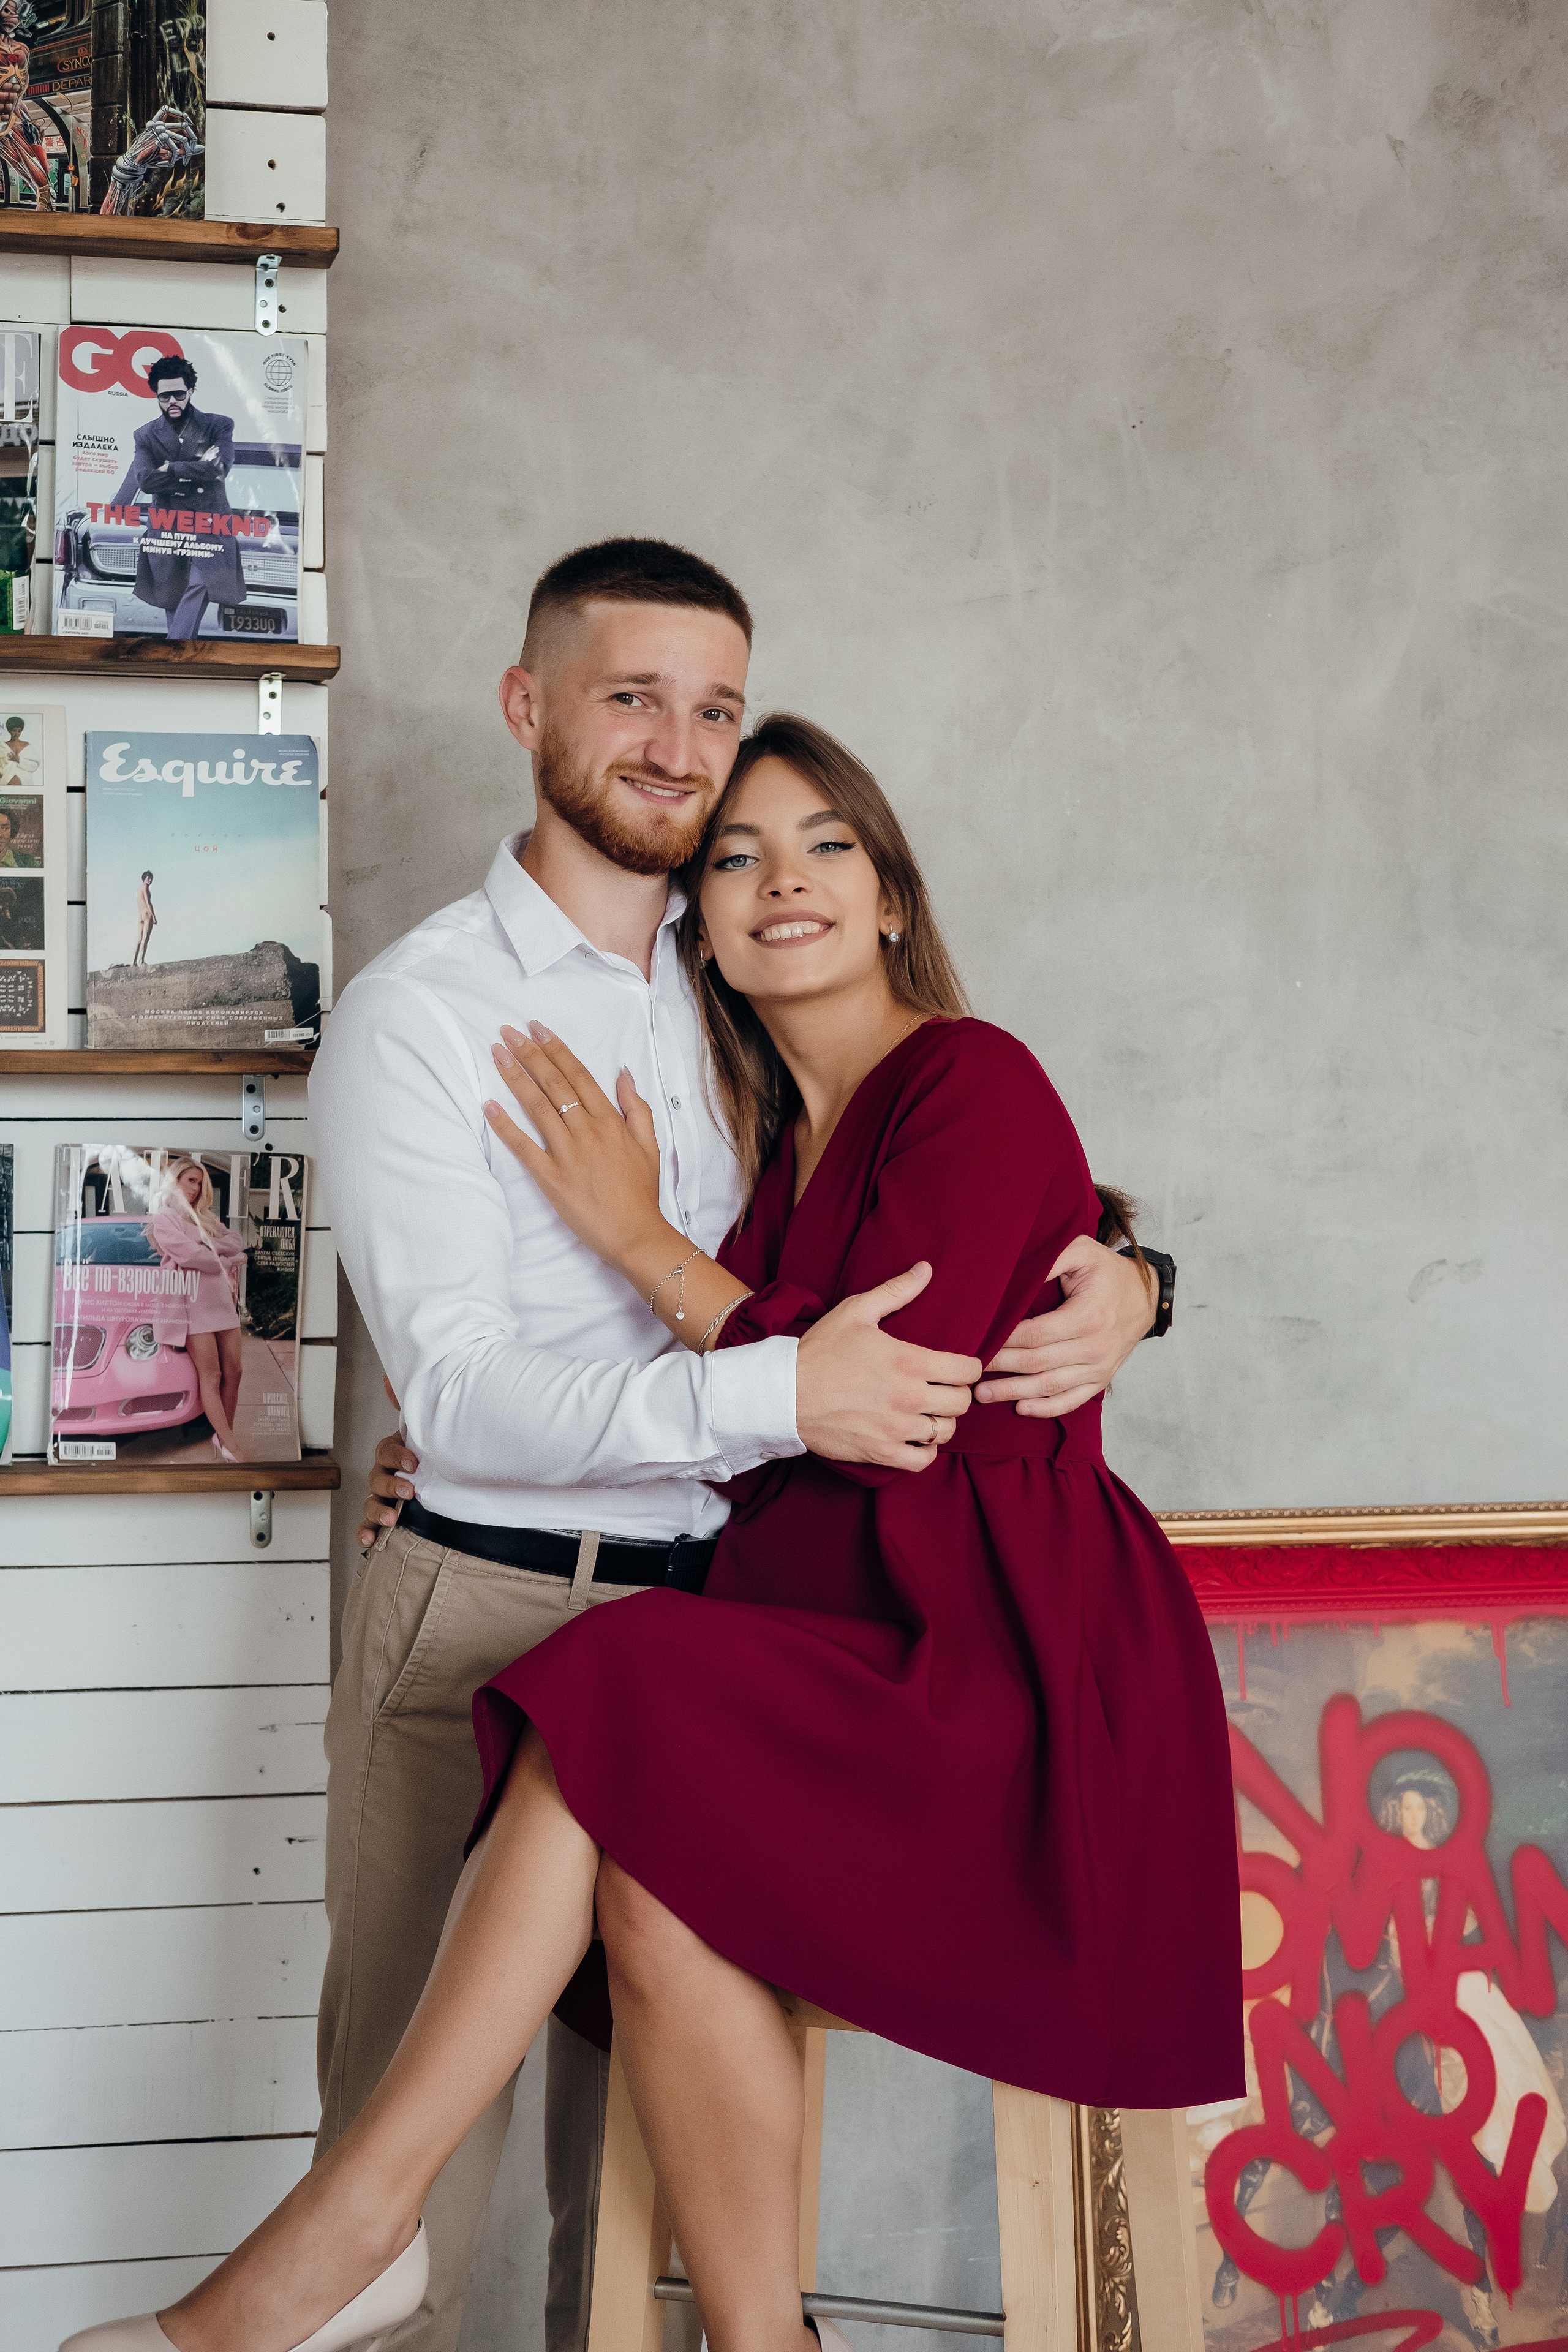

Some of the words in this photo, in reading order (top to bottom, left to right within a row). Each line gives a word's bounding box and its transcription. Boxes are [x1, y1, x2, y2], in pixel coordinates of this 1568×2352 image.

[59, 326, 184, 399] GQ
[72, 441, 119, 451] ИЗДАЛЕКА
[77, 434, 115, 443] СЛЫШНО
[86, 502, 141, 527] THE
[148, 507, 272, 538] WEEKND
[160, 532, 173, 540] НА
[174, 532, 197, 541] ПУТИ
[140, 538, 183, 548] ЛУЧШЕМУ
[183, 541, 225, 552] АЛЬБОМУ,
[142, 546, 172, 555] МИНУЯ
[99, 742, 312, 797] Esquire
[63, 1145, 301, 1221] TATER
[94, 1266, 201, 1303] по-взрослому
[1239, 1842, 1568, 2023] OMAN
[1248, 1991, 1498, 2132] NO
[1204, 2090, 1548, 2295] CRY
